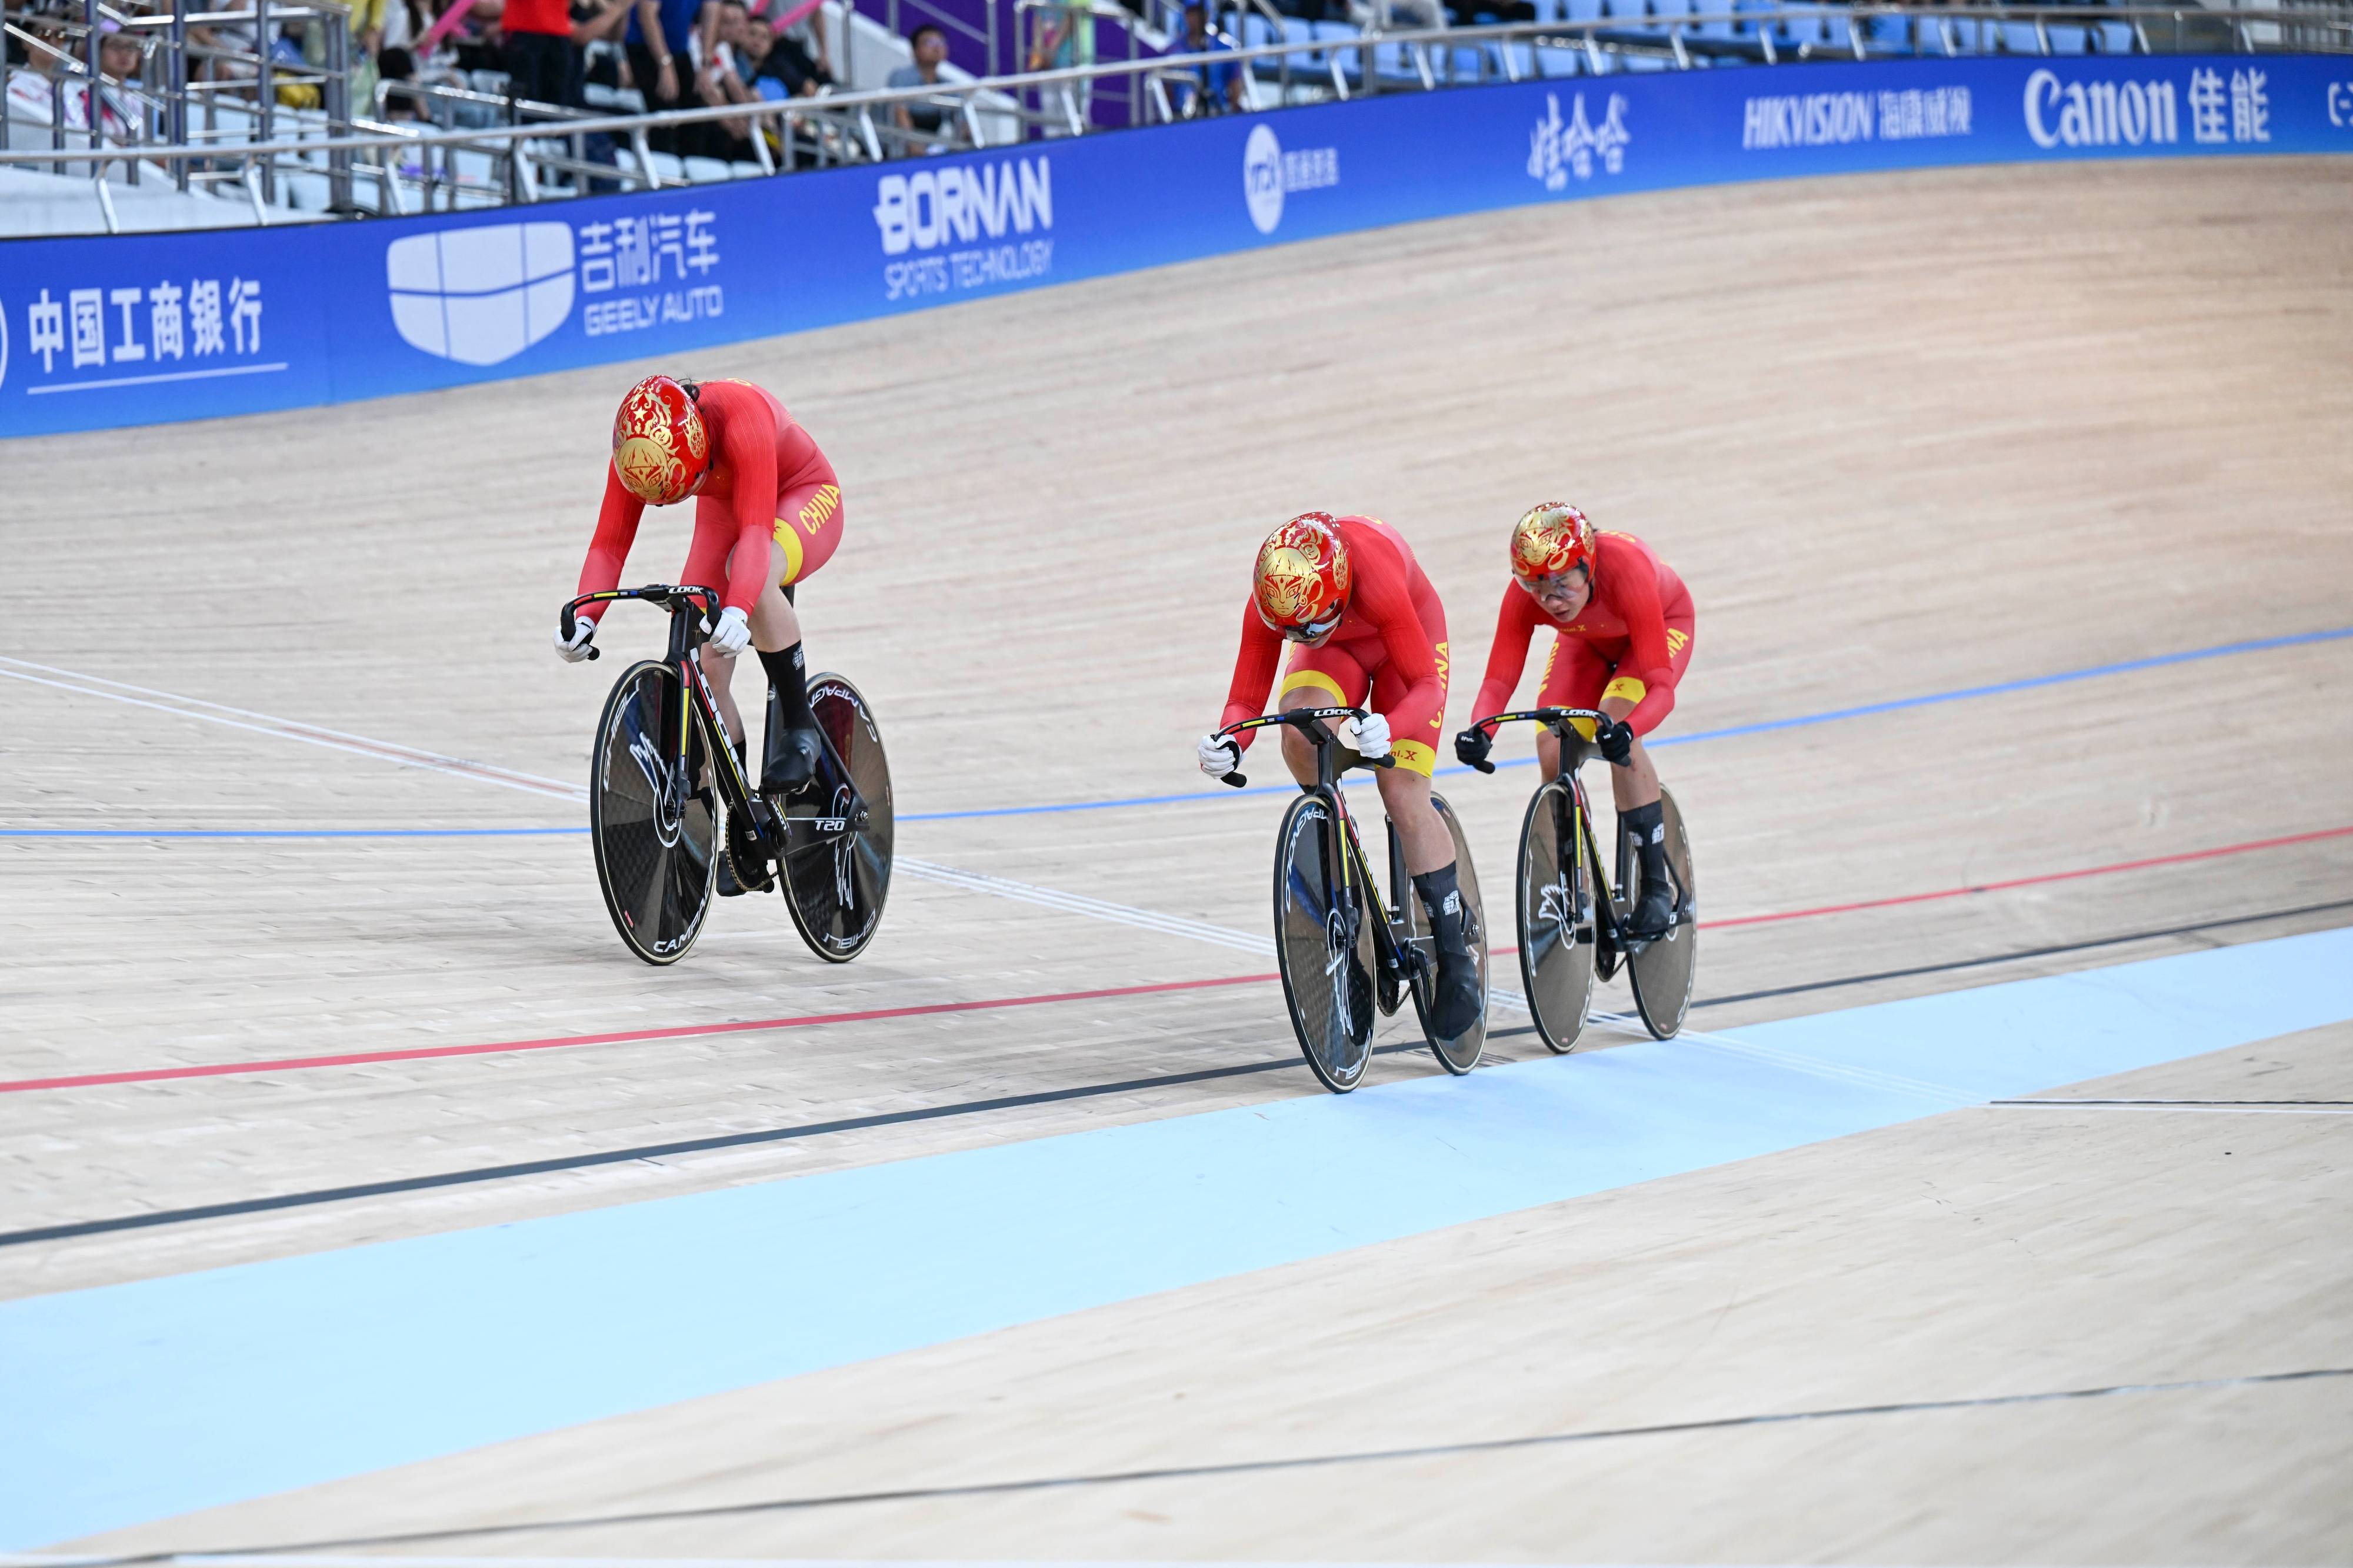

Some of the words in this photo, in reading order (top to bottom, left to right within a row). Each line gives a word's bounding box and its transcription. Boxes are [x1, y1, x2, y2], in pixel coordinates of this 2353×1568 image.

[1742, 90, 1875, 149] HIKVISION
[2024, 68, 2177, 149] Canon
[2188, 66, 2271, 144] 佳能
[872, 155, 1053, 256] BORNAN
[579, 207, 721, 293] 吉利汽车
[884, 255, 949, 301] SPORTS
[949, 238, 1054, 288] TECHNOLOGY
[28, 276, 263, 373] 中国工商银行
[584, 295, 661, 336] GEELY
[661, 285, 724, 323] AUTO
[799, 484, 840, 535] CHINA
[668, 586, 704, 594] LOOK
[690, 647, 749, 792] LOOK
[1314, 709, 1354, 717] LOOK
[815, 820, 845, 831] T20
